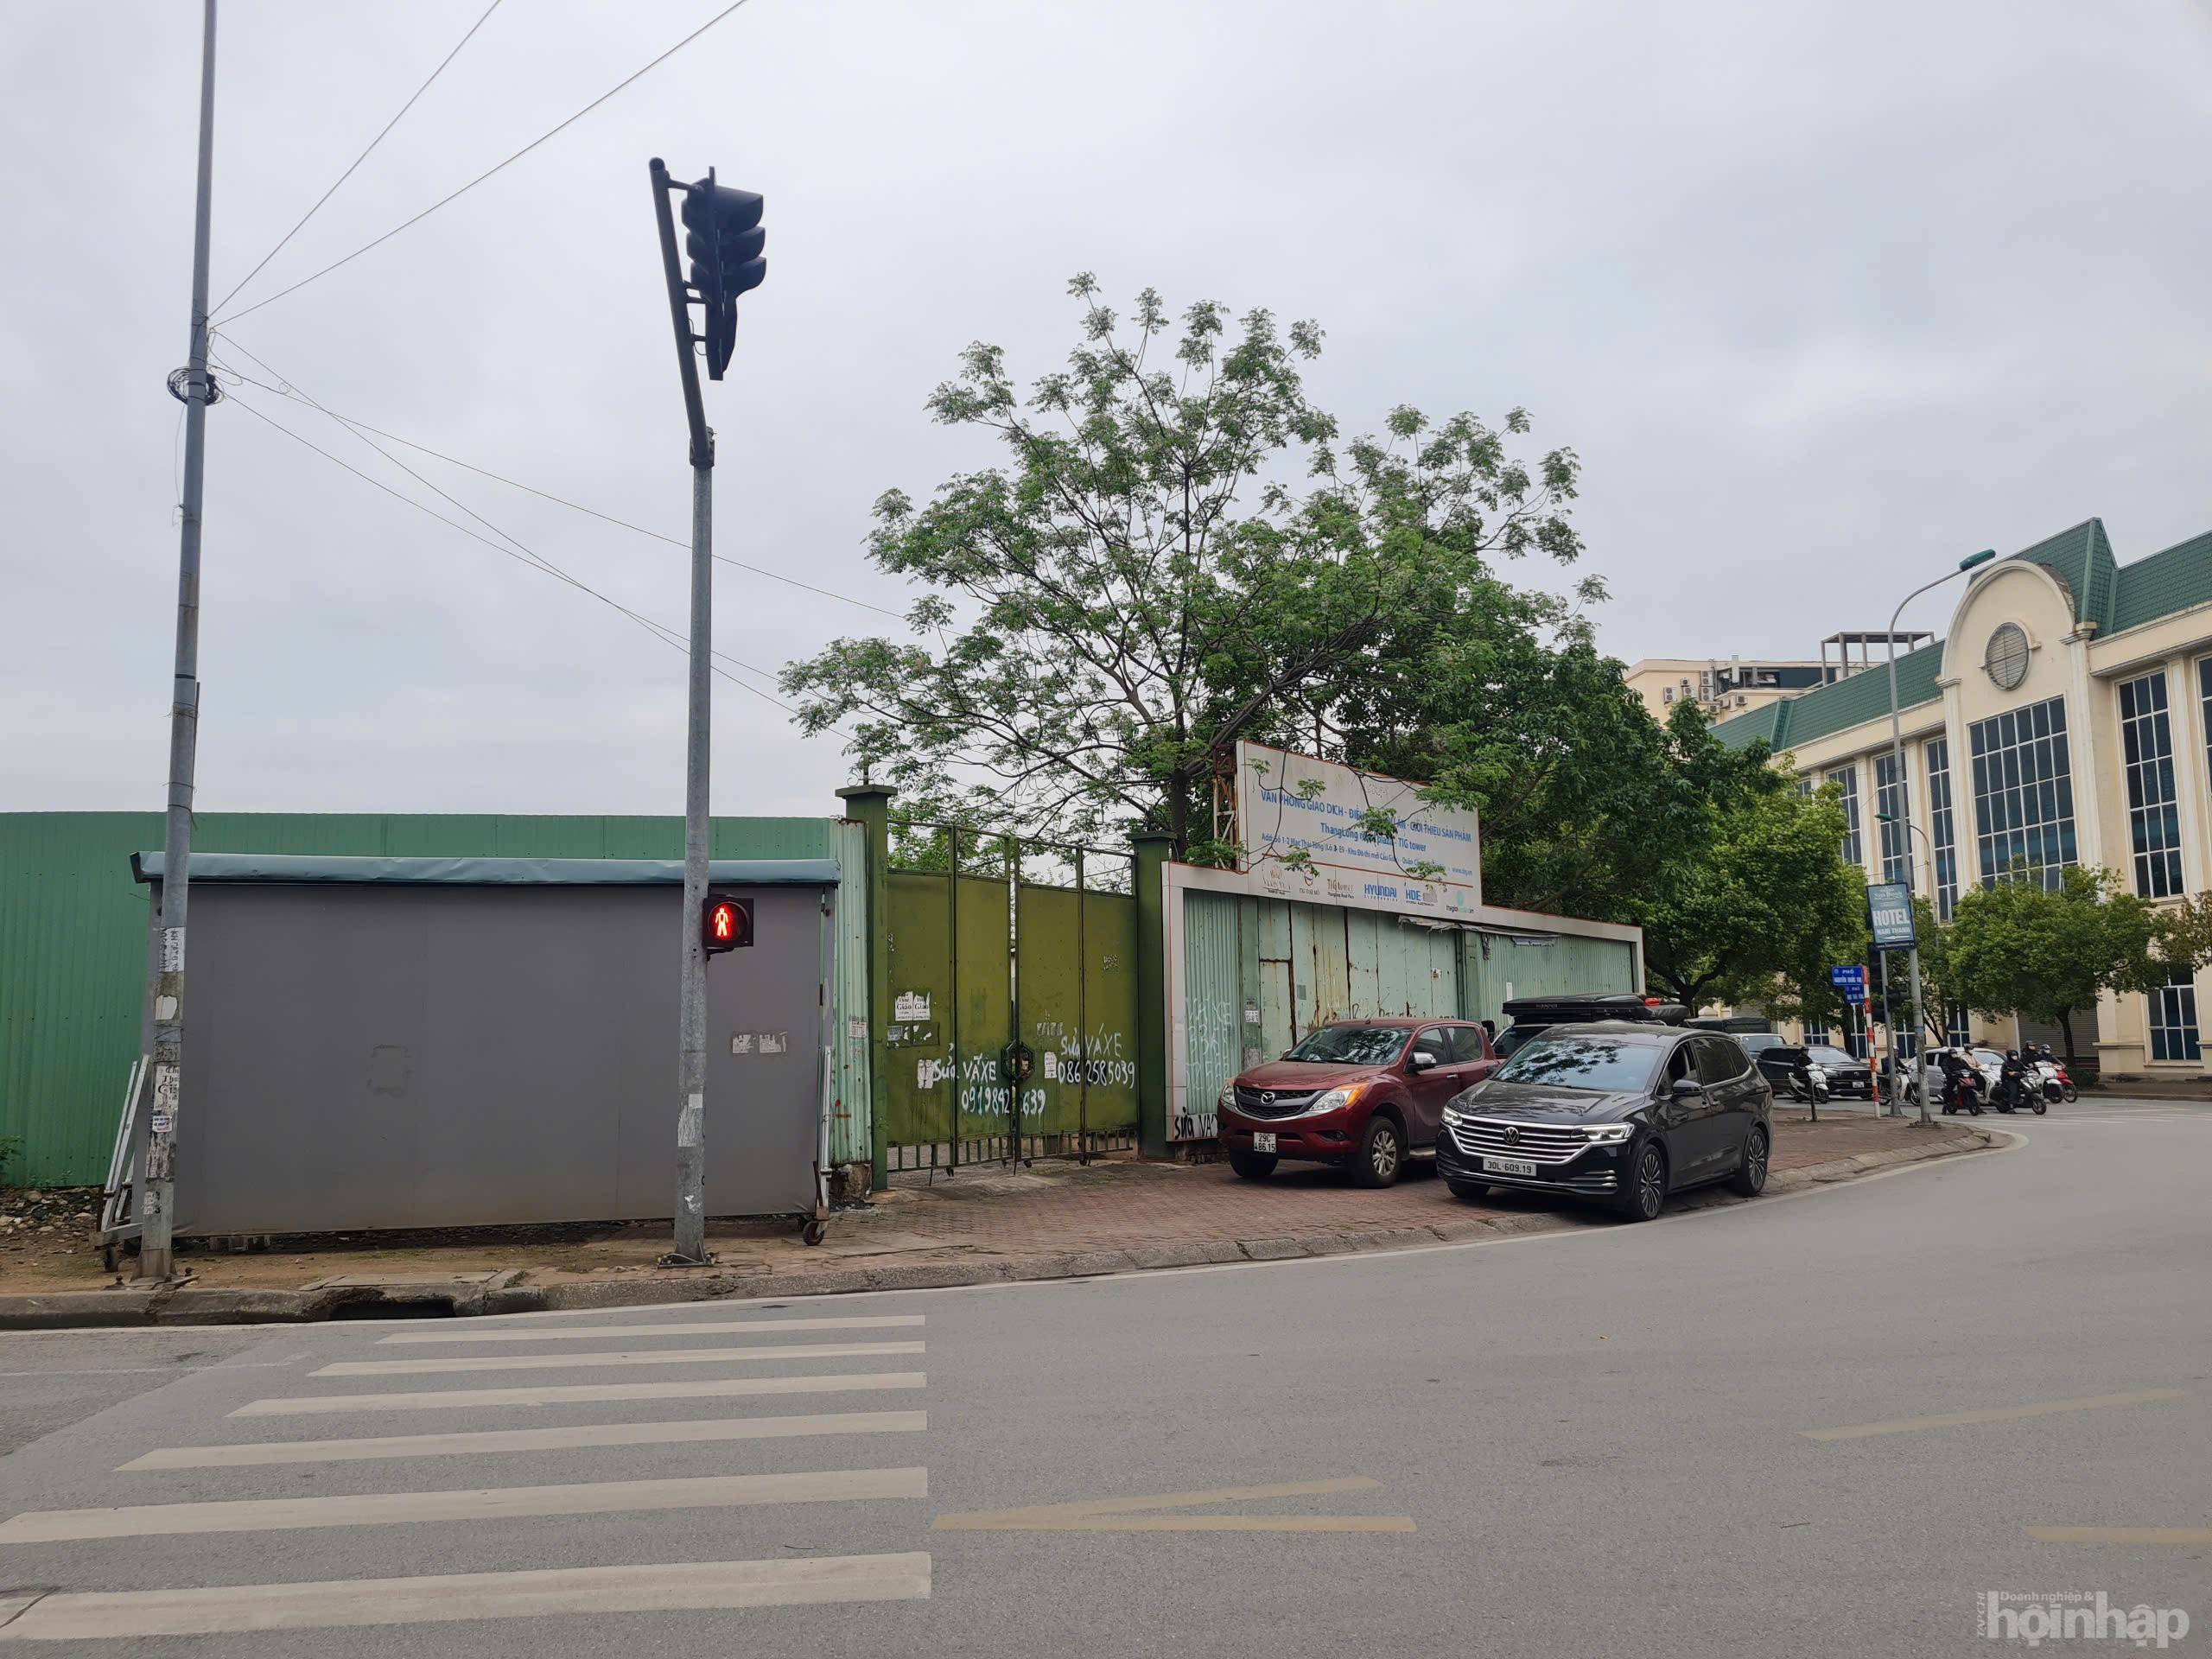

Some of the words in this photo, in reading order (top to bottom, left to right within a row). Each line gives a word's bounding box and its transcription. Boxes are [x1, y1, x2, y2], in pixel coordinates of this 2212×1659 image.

[1398, 837, 1408, 849] TIG
[1409, 841, 1427, 852] tower
[1364, 884, 1397, 899] HYUNDAI
[1406, 889, 1421, 900] HDE
[1872, 908, 1910, 926] HOTEL
[1258, 1134, 1271, 1142] 29C
